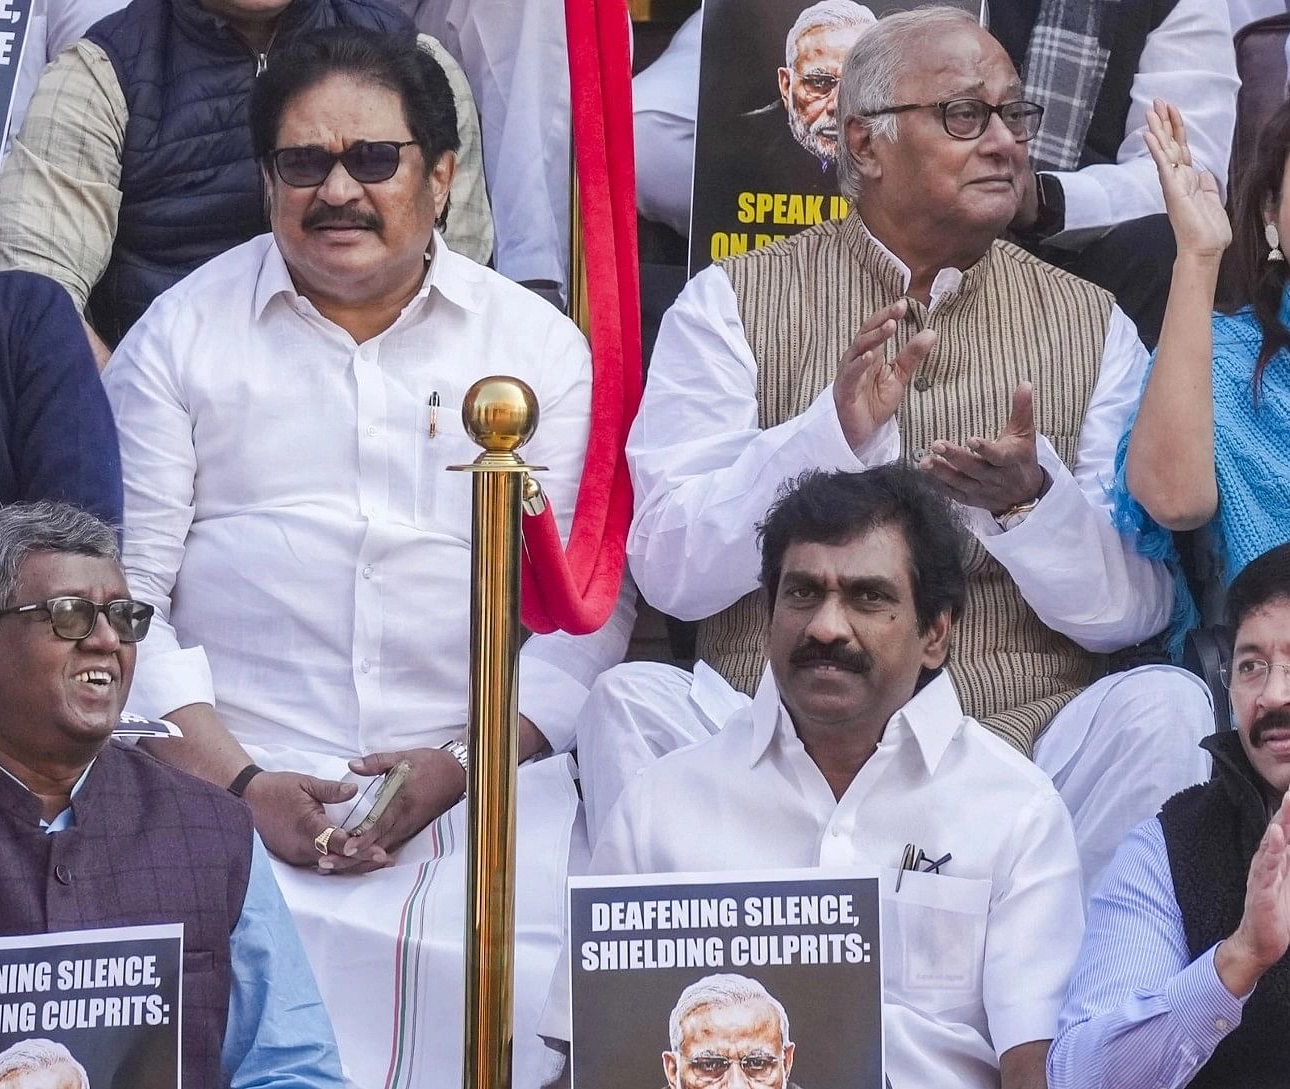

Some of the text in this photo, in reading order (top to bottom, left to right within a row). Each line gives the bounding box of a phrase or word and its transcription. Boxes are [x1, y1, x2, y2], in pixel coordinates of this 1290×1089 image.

[737, 192, 824, 226] SPEAK
[711, 232, 748, 262] ON
[591, 894, 860, 932] DEAFENING SILENCE,
[581, 932, 871, 971] SHIELDING CULPRITS:
[57, 955, 162, 990] SILENCE,
[41, 994, 170, 1031] CULPRITS:
